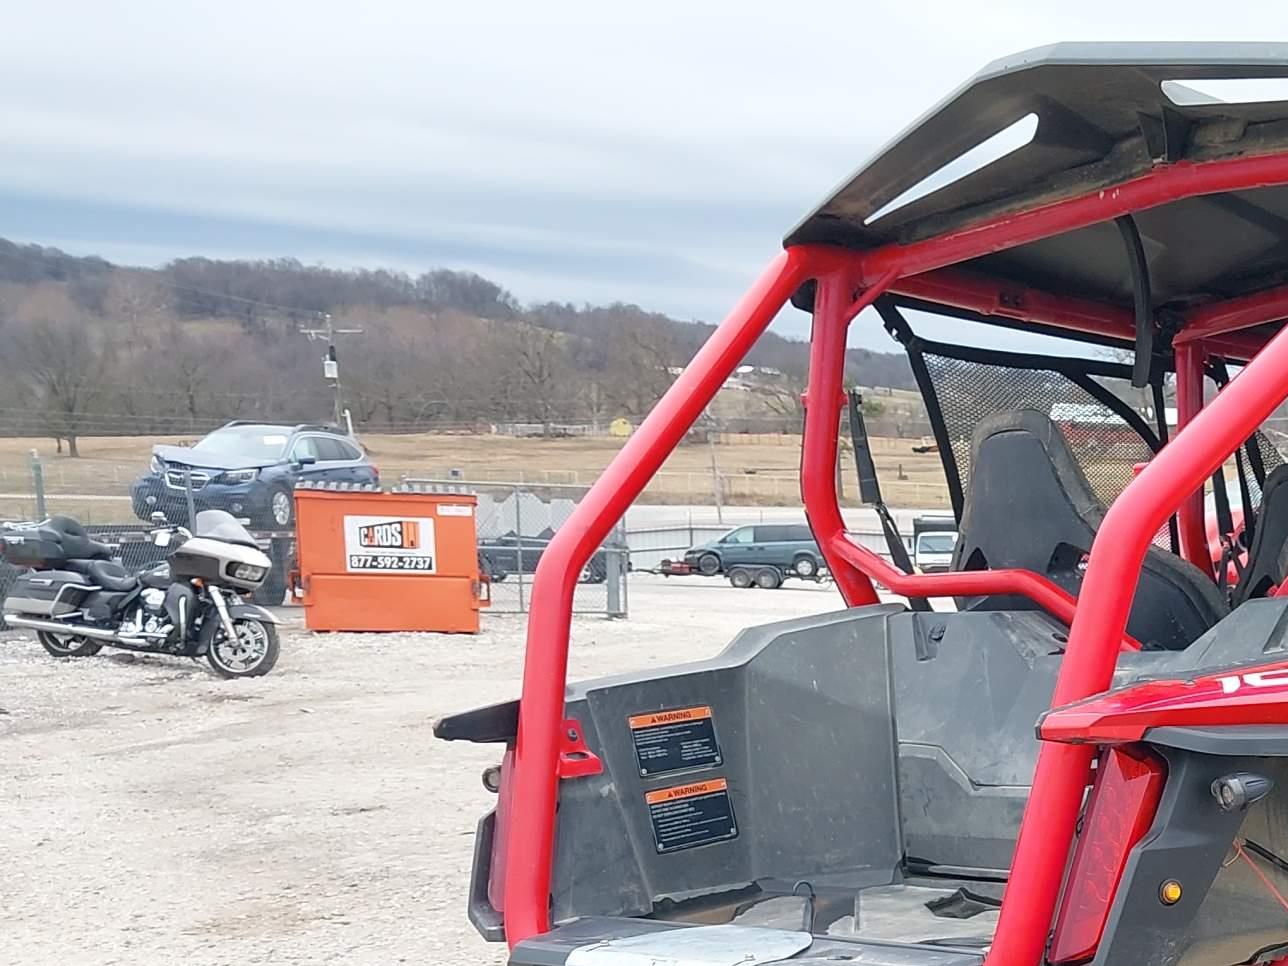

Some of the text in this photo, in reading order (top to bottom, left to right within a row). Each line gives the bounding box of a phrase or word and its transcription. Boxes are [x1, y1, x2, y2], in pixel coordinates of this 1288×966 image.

[360, 522, 402, 547] CARDS
[350, 556, 432, 569] 877-592-2737
[656, 711, 692, 723] WARNING
[673, 784, 708, 797] WARNING
